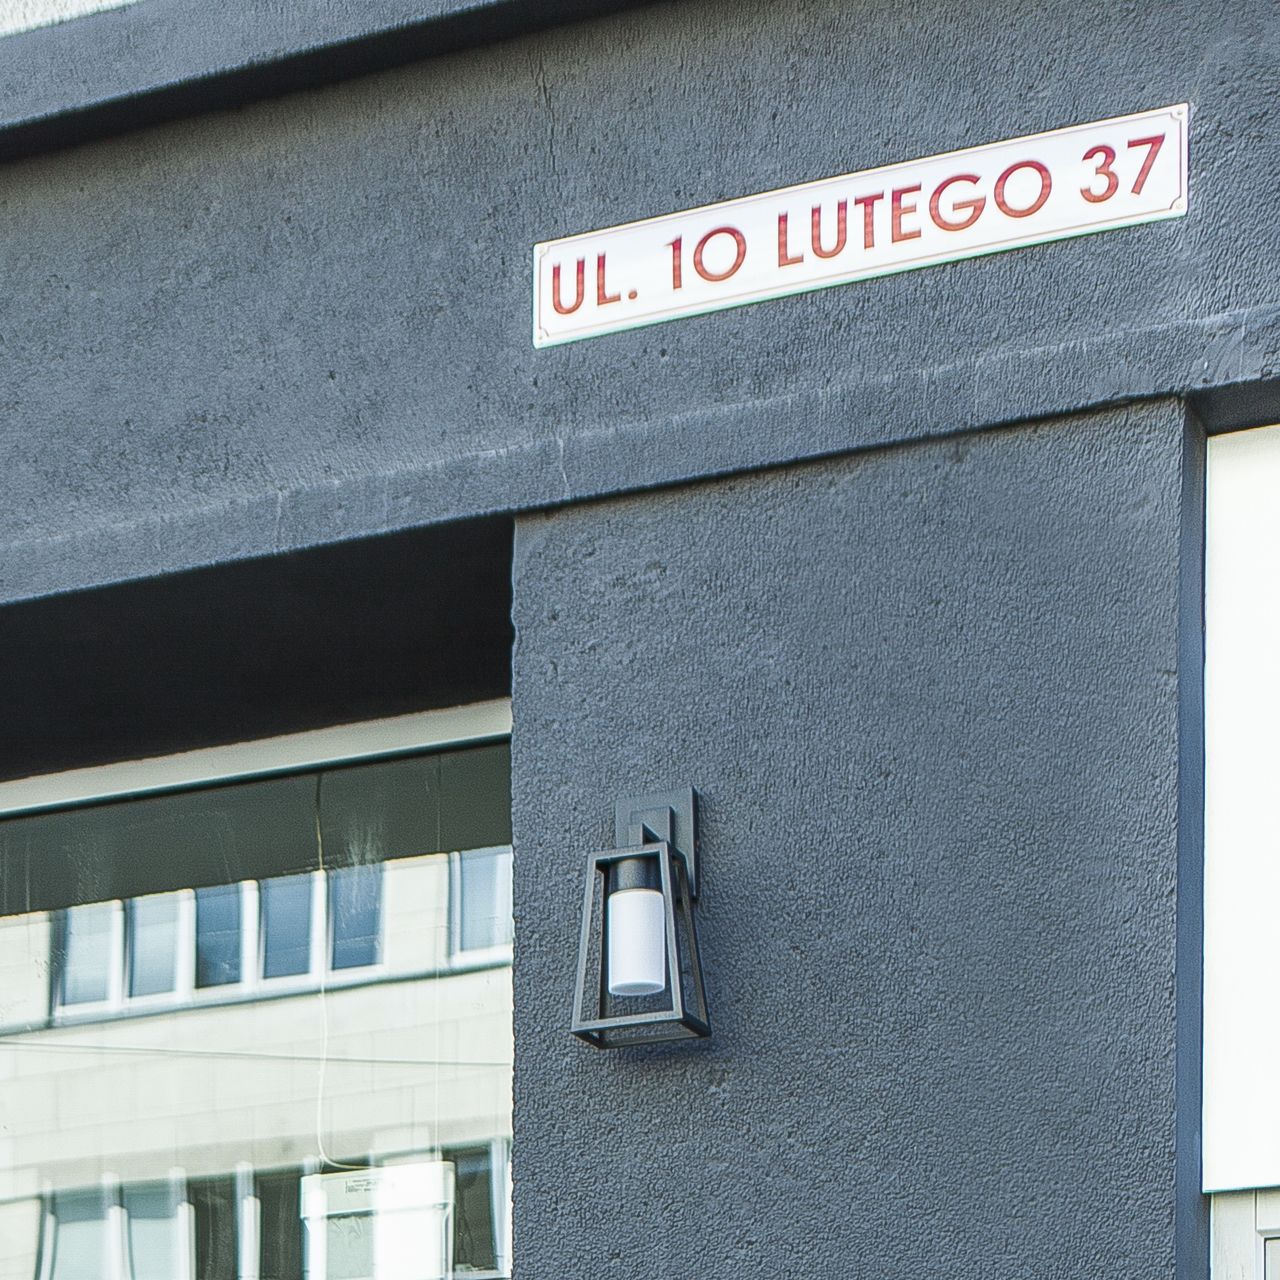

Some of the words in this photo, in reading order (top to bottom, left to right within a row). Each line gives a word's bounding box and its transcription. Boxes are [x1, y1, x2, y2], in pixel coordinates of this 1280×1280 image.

[551, 253, 638, 315] UL.
[664, 225, 747, 289] 10
[777, 159, 1052, 268] LUTEGO
[1079, 133, 1167, 204] 37
